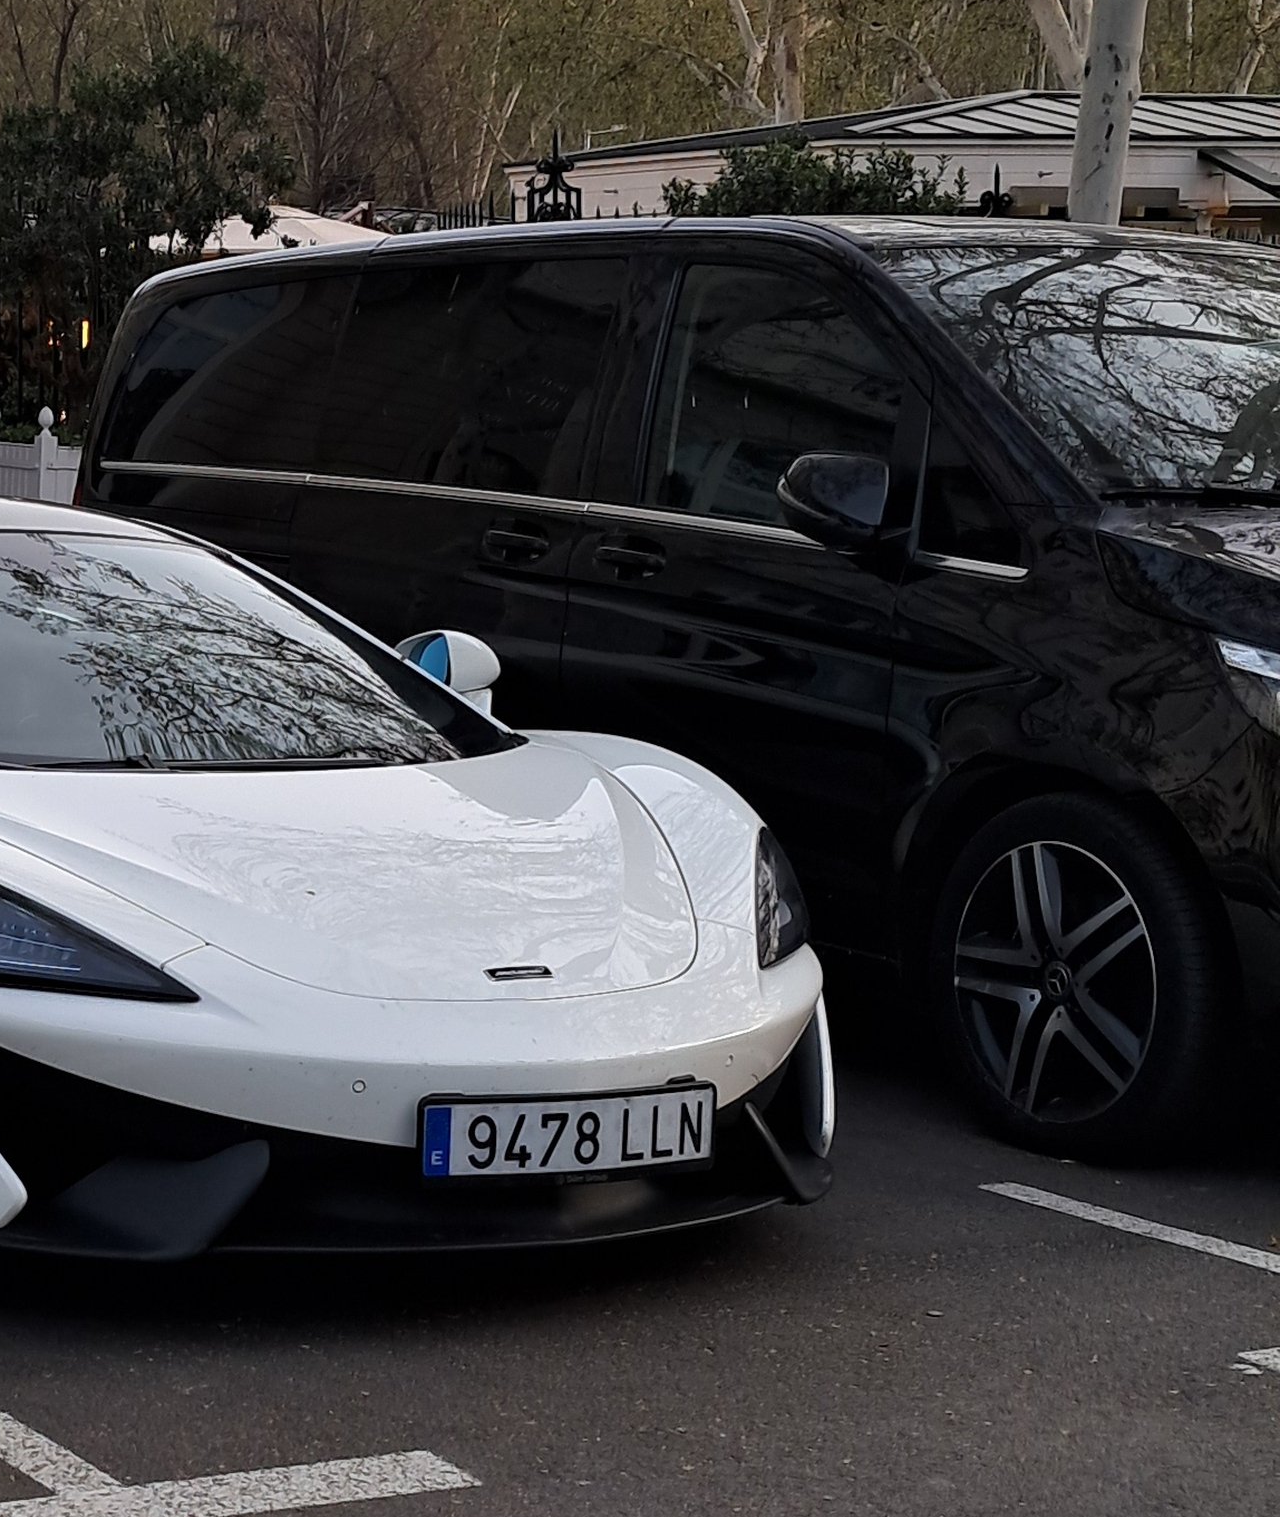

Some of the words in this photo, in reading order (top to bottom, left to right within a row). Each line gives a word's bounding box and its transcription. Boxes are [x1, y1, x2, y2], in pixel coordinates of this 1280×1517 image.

[431, 1151, 444, 1166] E
[467, 1111, 601, 1169] 9478
[620, 1101, 703, 1161] LLN
